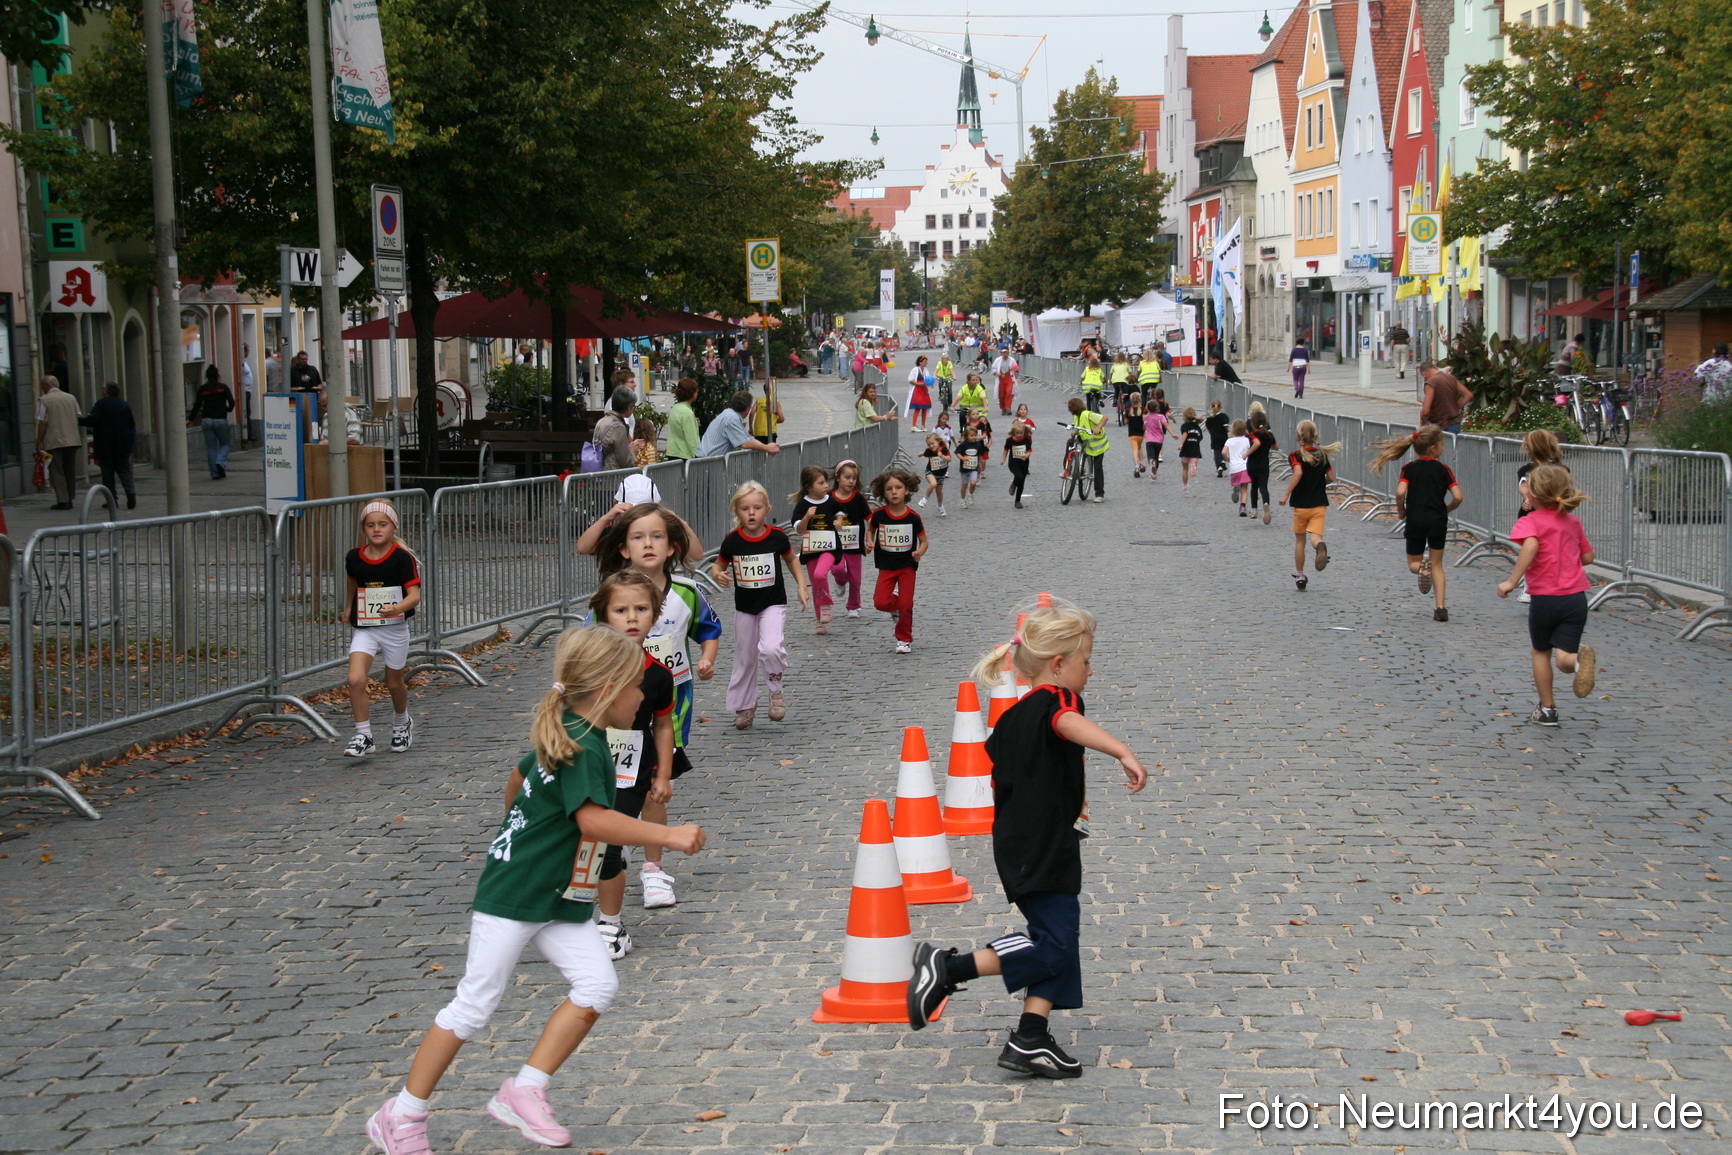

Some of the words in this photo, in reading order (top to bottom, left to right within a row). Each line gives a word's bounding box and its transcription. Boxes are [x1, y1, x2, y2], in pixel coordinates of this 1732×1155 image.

[937, 47, 958, 58] POTAIN
[383, 236, 396, 247] ZONE
[267, 445, 282, 455] Zukunft
[274, 459, 292, 469] Familien.
[887, 535, 910, 543] 7188
[812, 541, 833, 549] 7224
[743, 564, 771, 576] 7182
[367, 592, 396, 600] Victoria
[368, 601, 398, 613] 72
[657, 651, 684, 670] 62
[609, 738, 638, 752] rina
[612, 752, 633, 769] 14
